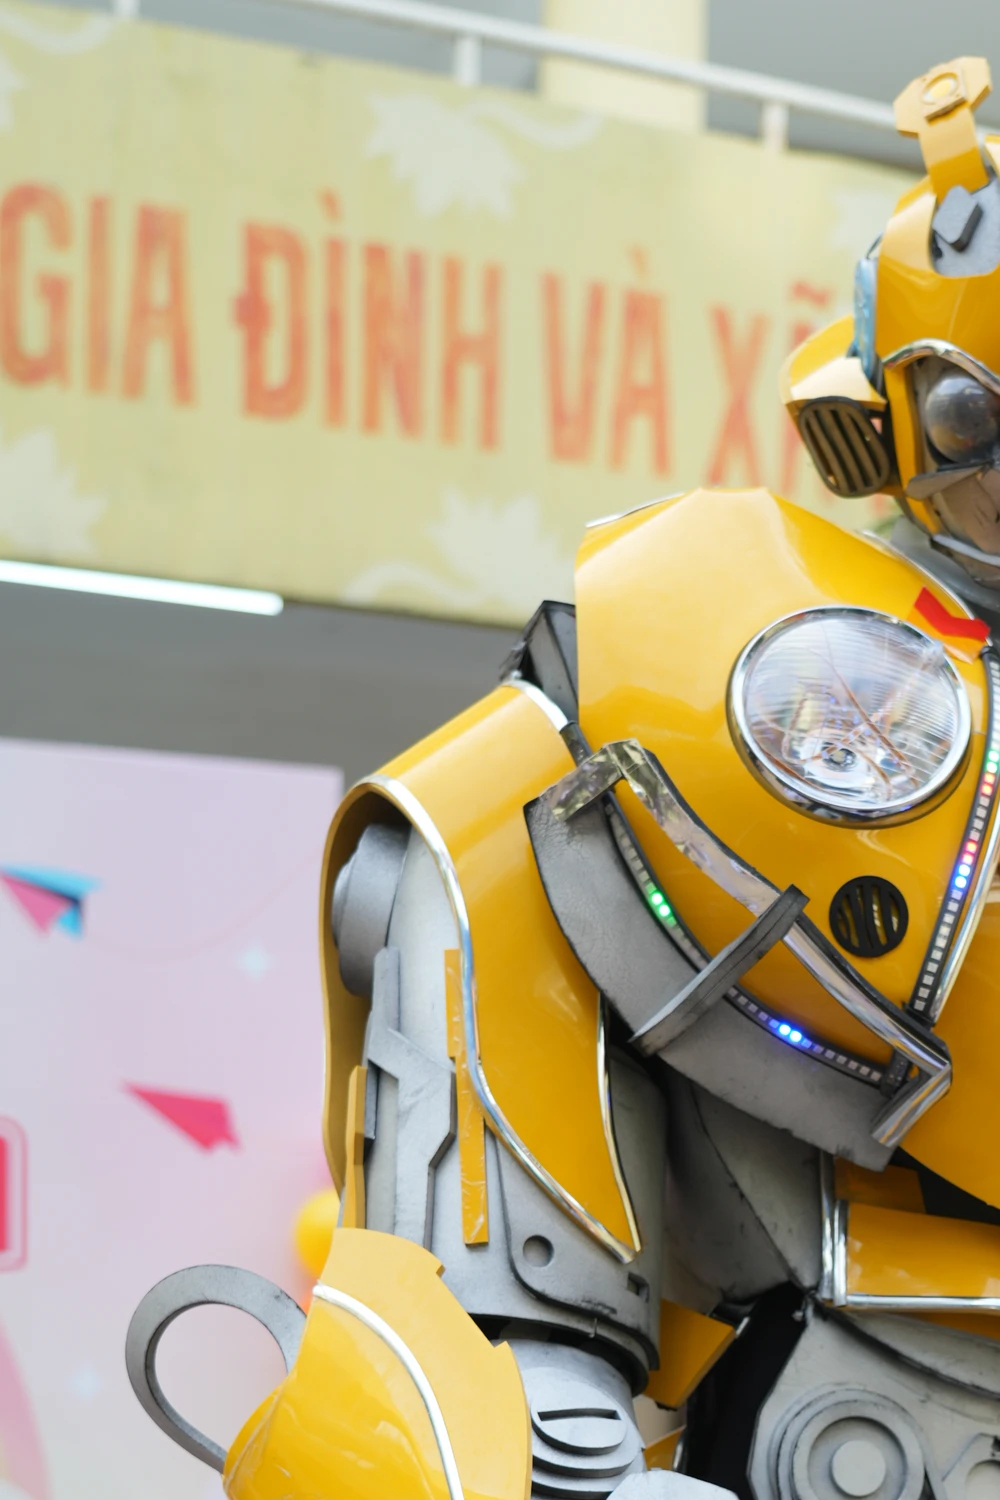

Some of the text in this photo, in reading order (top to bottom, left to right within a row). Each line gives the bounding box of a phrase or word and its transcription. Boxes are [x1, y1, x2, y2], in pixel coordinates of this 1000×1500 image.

[0, 181, 196, 406] GIA
[232, 187, 504, 452] ĐÌNH
[540, 246, 672, 478] VÀ
